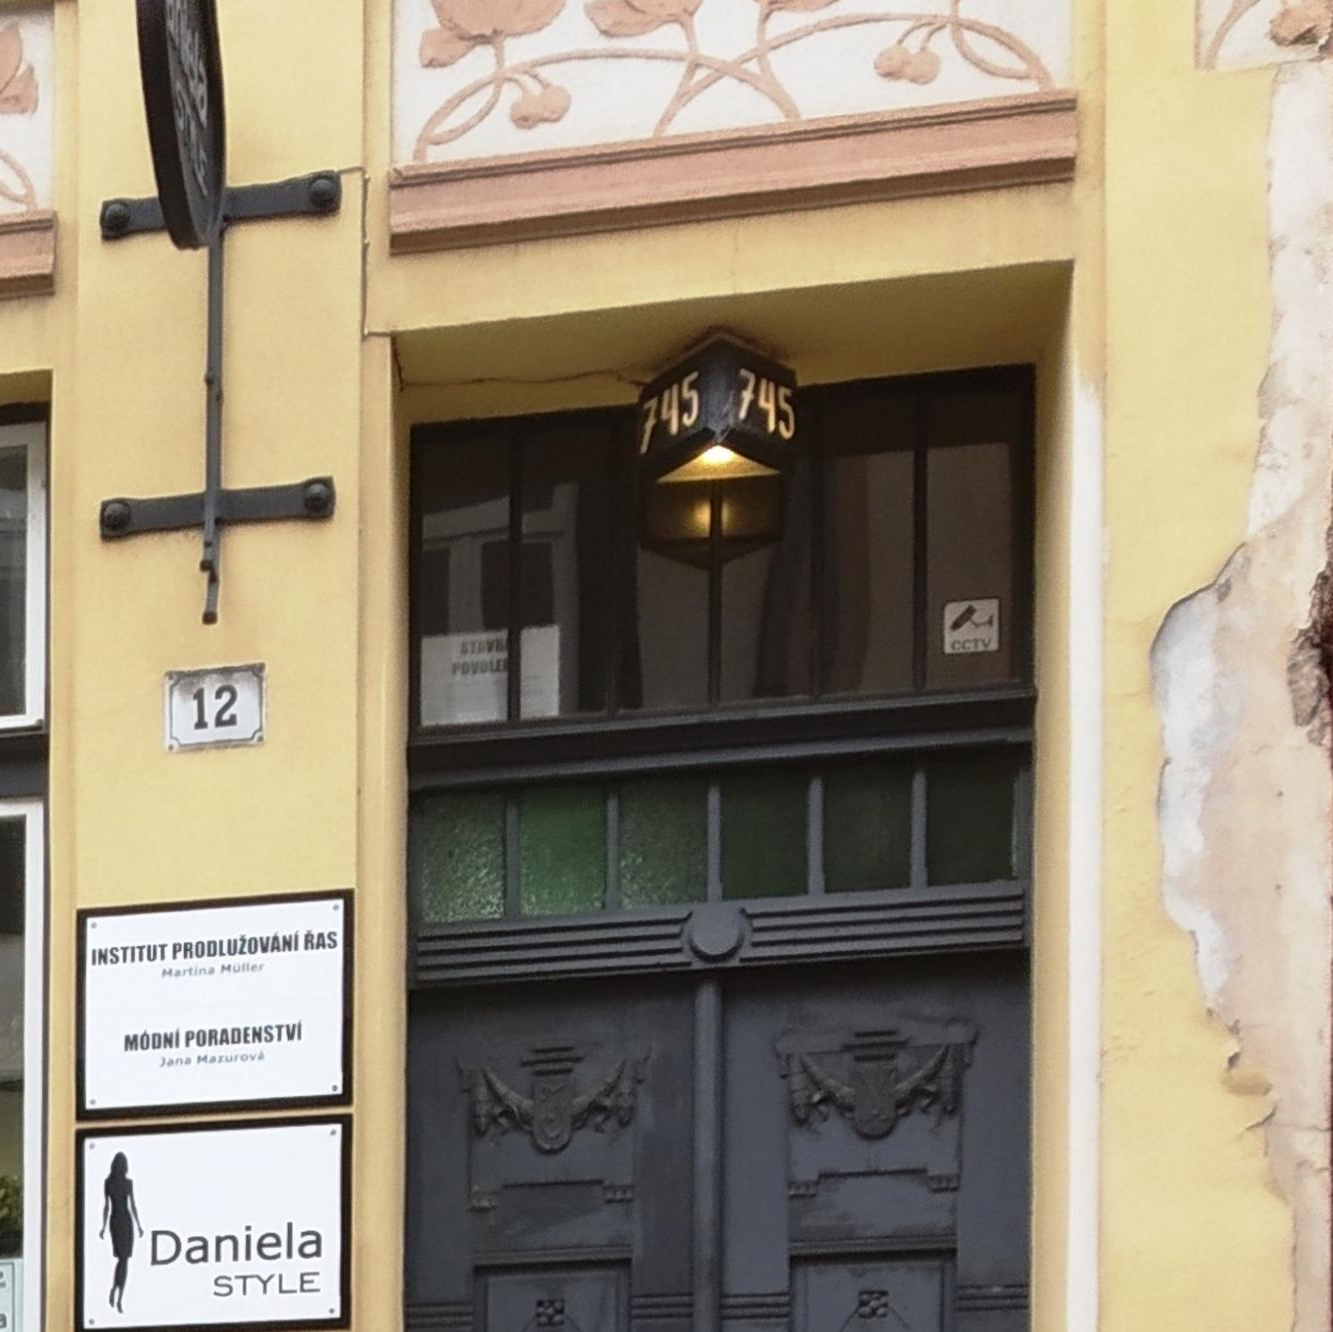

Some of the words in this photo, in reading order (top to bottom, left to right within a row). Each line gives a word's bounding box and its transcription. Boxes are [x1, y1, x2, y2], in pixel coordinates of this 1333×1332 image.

[640, 371, 699, 454] 745
[739, 368, 795, 439] 745
[951, 638, 991, 651] CCTV
[193, 684, 238, 730] 12
[91, 943, 168, 966] INSTITUT
[172, 930, 299, 960] PRODLUŽOVÁNÍ
[304, 930, 338, 951] ŘAS
[161, 964, 215, 979] Martina
[220, 961, 264, 974] Müller
[124, 1028, 180, 1052] MÓDNÍ
[185, 1020, 302, 1048] PORADENSTVÍ
[160, 1055, 192, 1068] Jana
[197, 1050, 265, 1065] Mazurová
[150, 1222, 323, 1266] Daniela
[213, 1271, 321, 1297] STYLE
